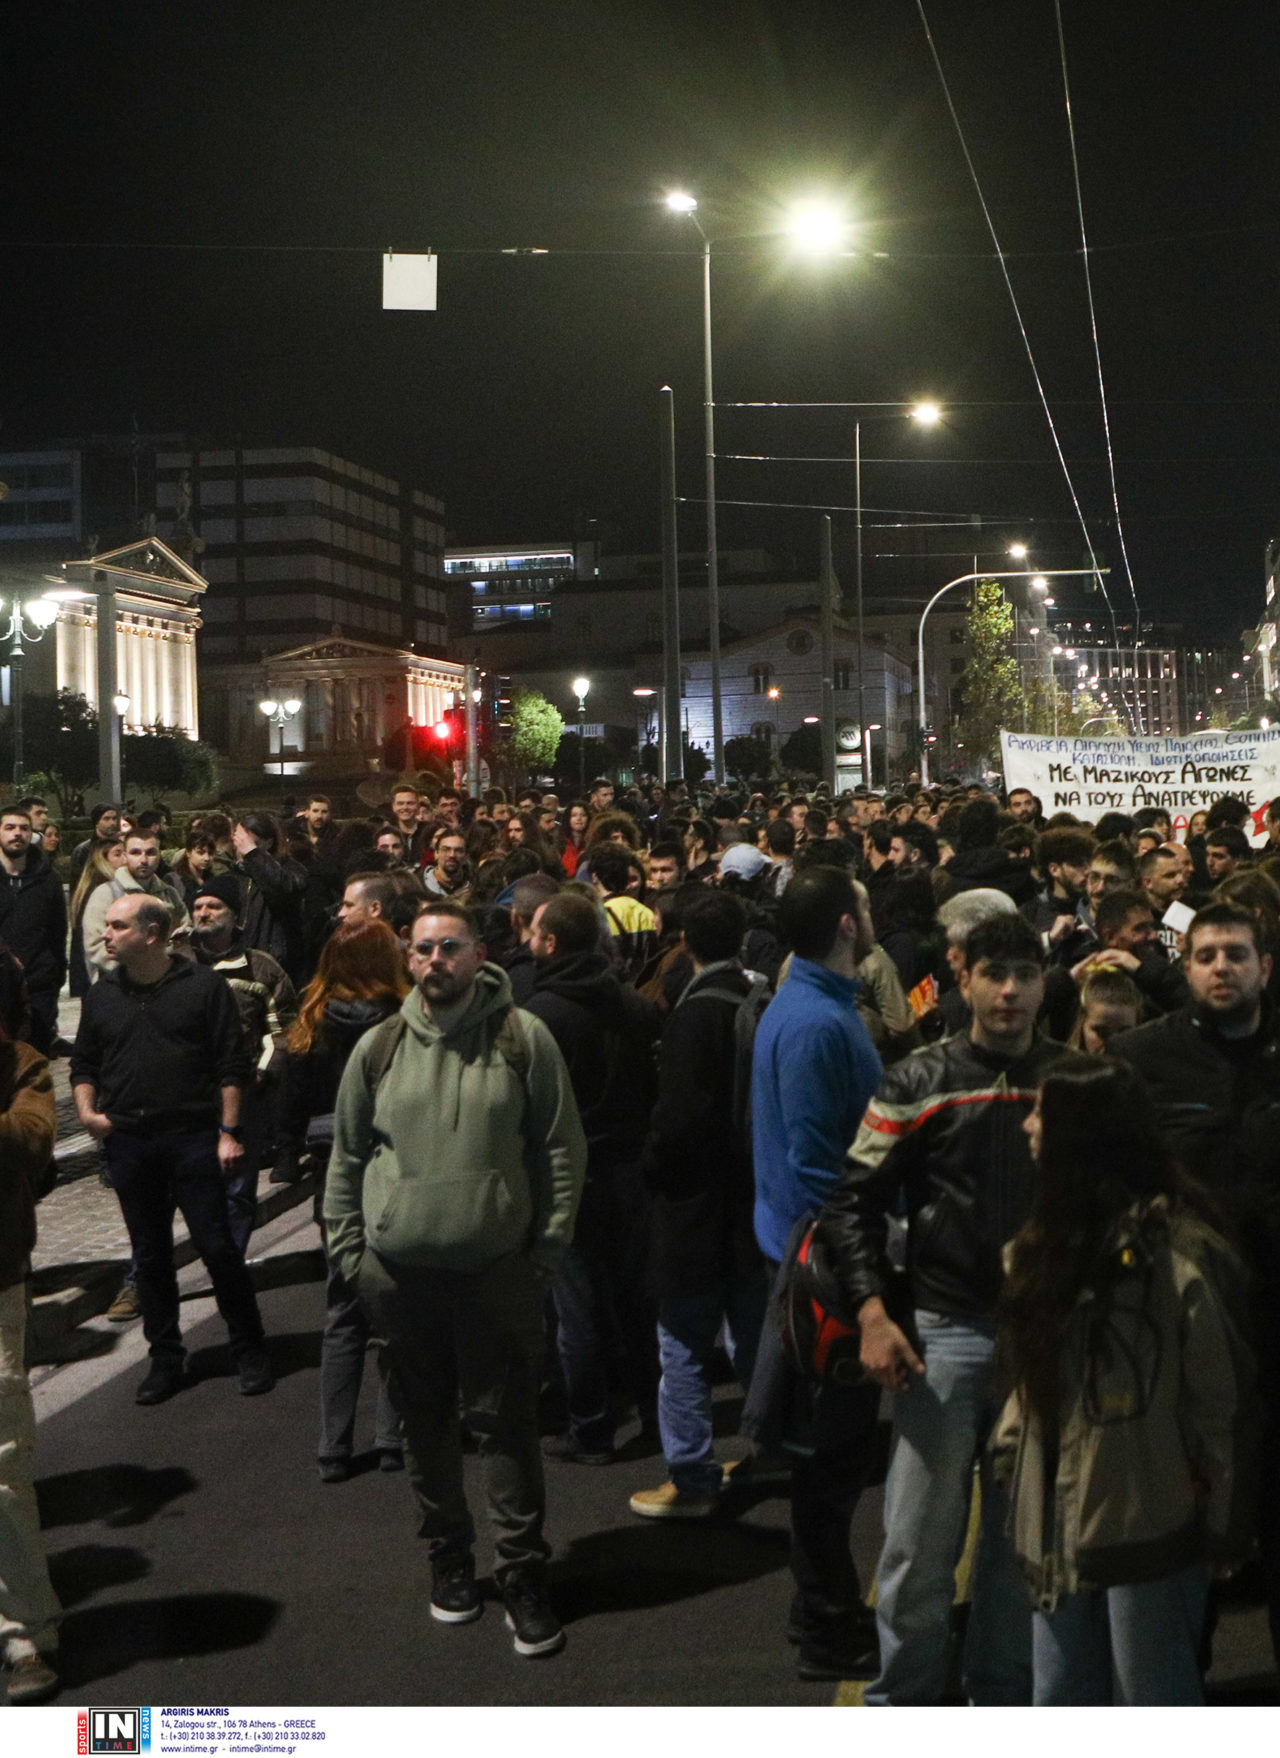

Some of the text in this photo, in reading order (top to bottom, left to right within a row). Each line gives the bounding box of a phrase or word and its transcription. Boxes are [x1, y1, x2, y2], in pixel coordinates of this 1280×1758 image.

[1083, 764, 1176, 784] ΜΑΖΙΚΟΥΣ
[1181, 761, 1253, 784] ΑΓΩΝΕΣ
[1054, 791, 1081, 807] ΝΑ
[1087, 791, 1126, 808] ΤΟΥΣ
